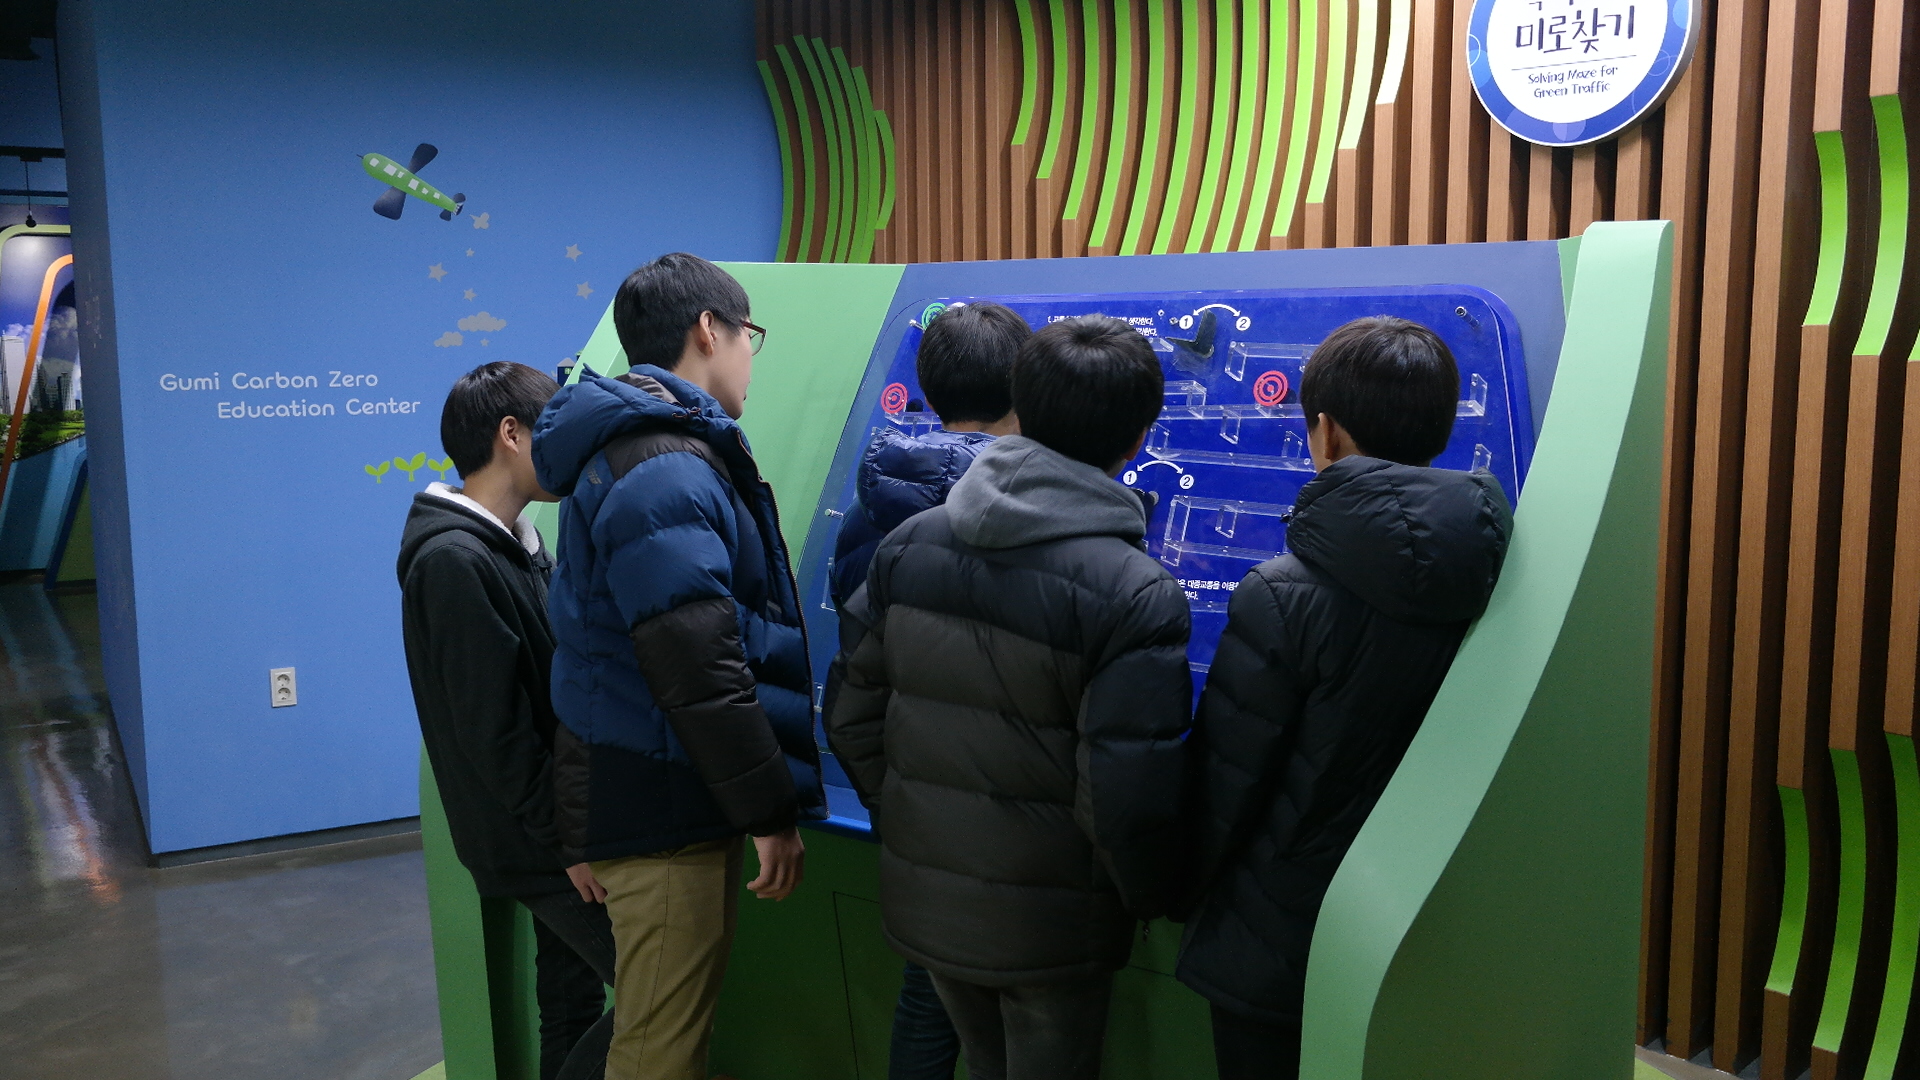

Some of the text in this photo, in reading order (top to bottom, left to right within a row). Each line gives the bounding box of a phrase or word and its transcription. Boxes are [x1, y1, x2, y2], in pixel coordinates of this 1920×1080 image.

[1515, 5, 1635, 53] 미로찾기
[1528, 65, 1618, 84] Solving Maze for
[1533, 81, 1611, 98] Green Traffic
[159, 371, 379, 391] Gumi Carbon Zero
[217, 397, 421, 419] Education Center
[1187, 579, 1221, 590] 대중교통을
